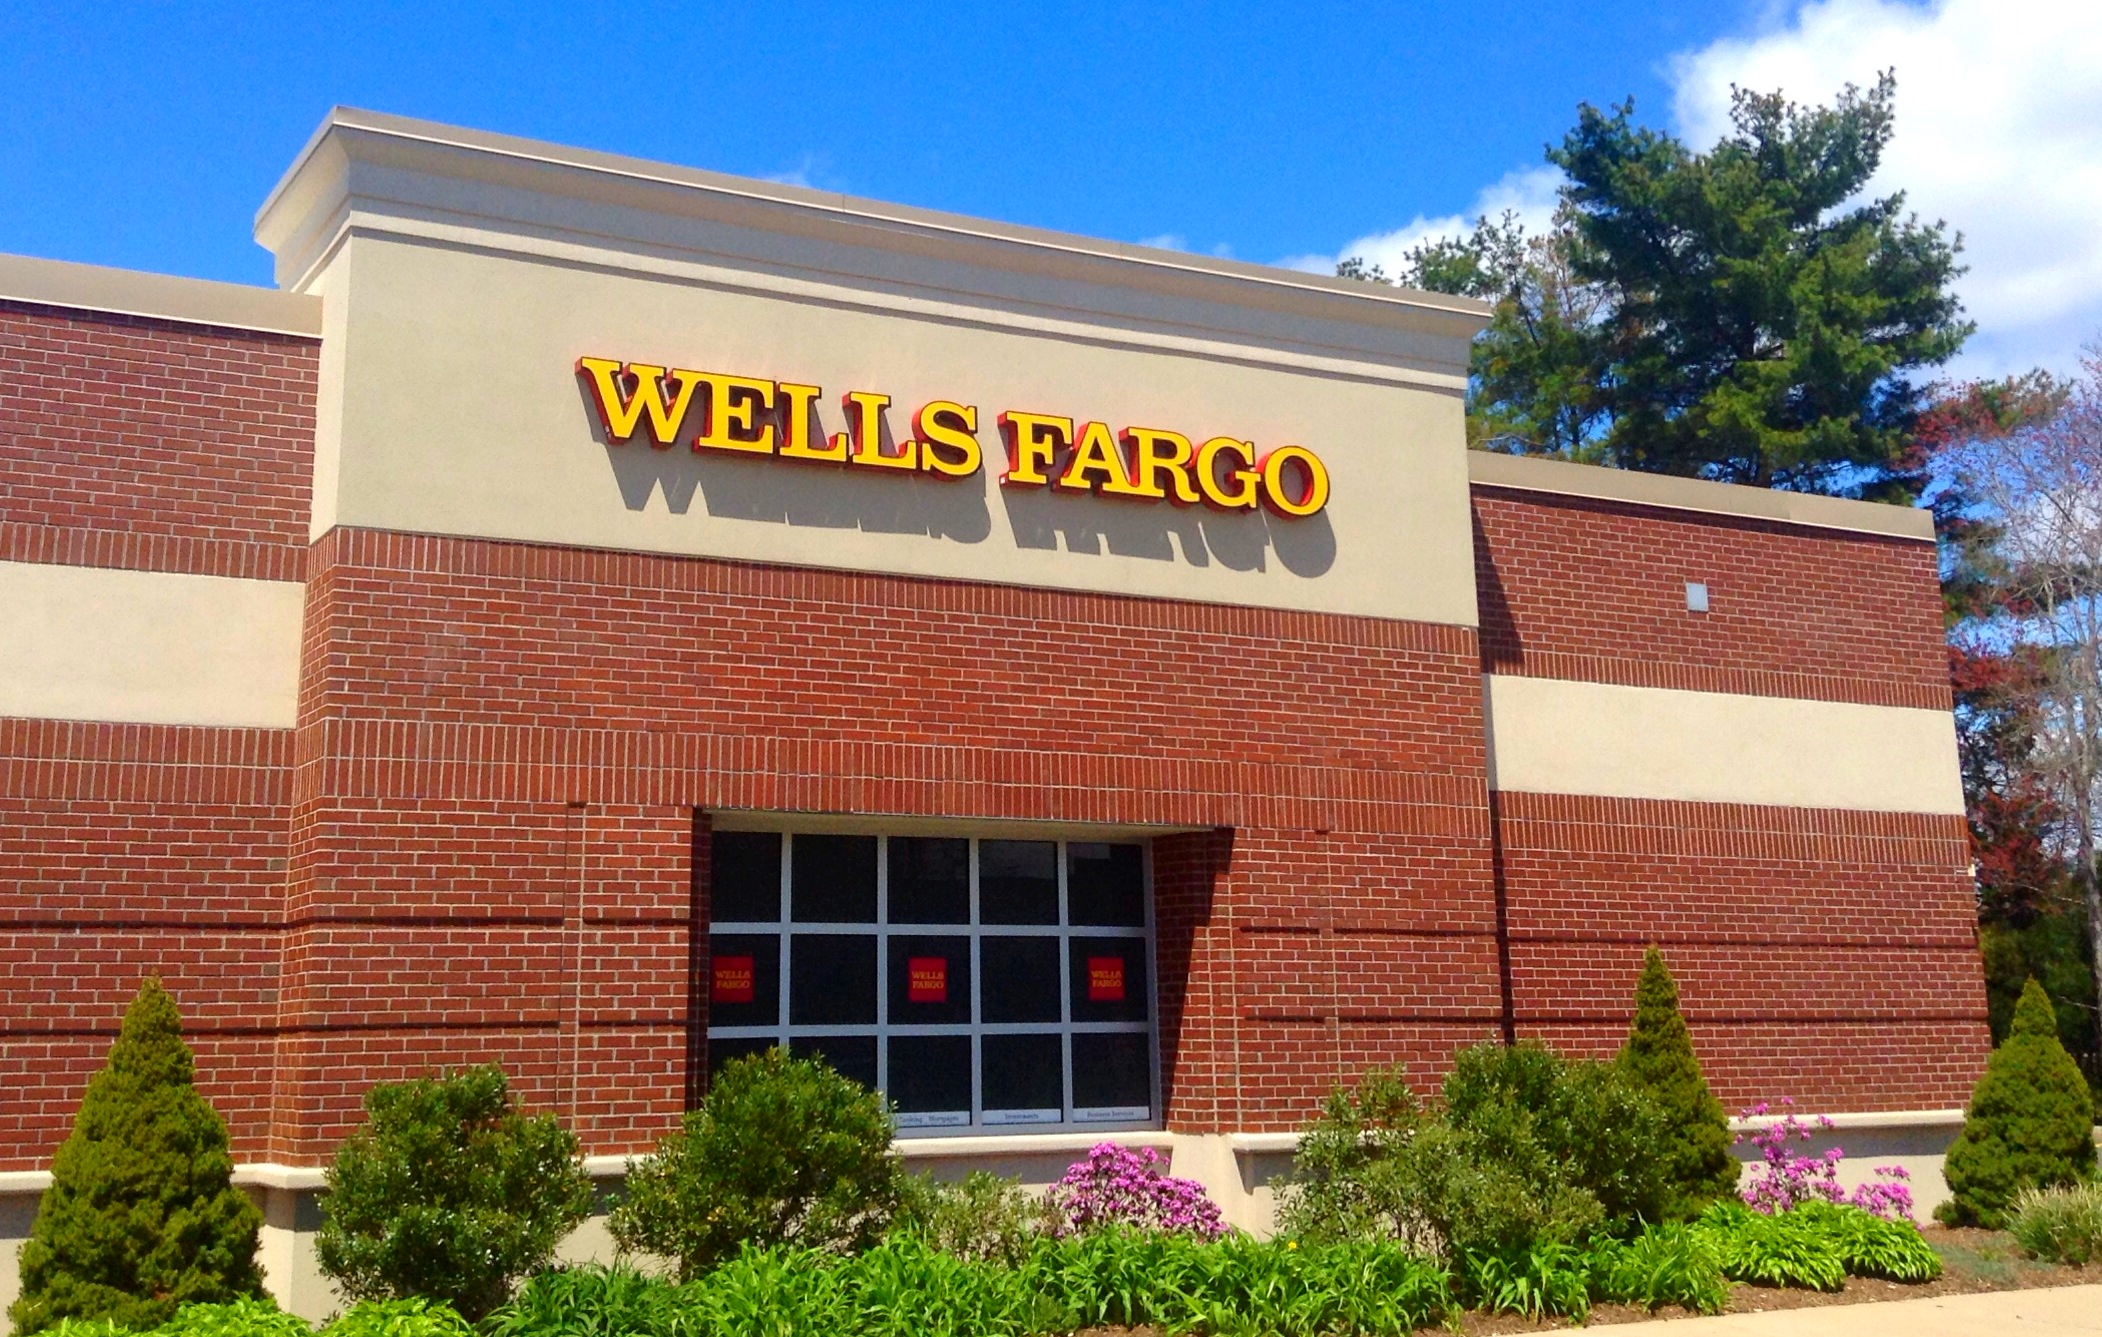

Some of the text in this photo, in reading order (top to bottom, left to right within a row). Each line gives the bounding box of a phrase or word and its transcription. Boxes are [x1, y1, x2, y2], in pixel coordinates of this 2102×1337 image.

[580, 357, 1330, 517] WELLS FARGO
[715, 970, 751, 979] WELLS
[911, 971, 945, 980] WELLS
[1091, 970, 1122, 979] WELLS
[716, 980, 751, 989] FARGO
[912, 980, 945, 989] FARGO
[1092, 979, 1122, 988] FARGO
